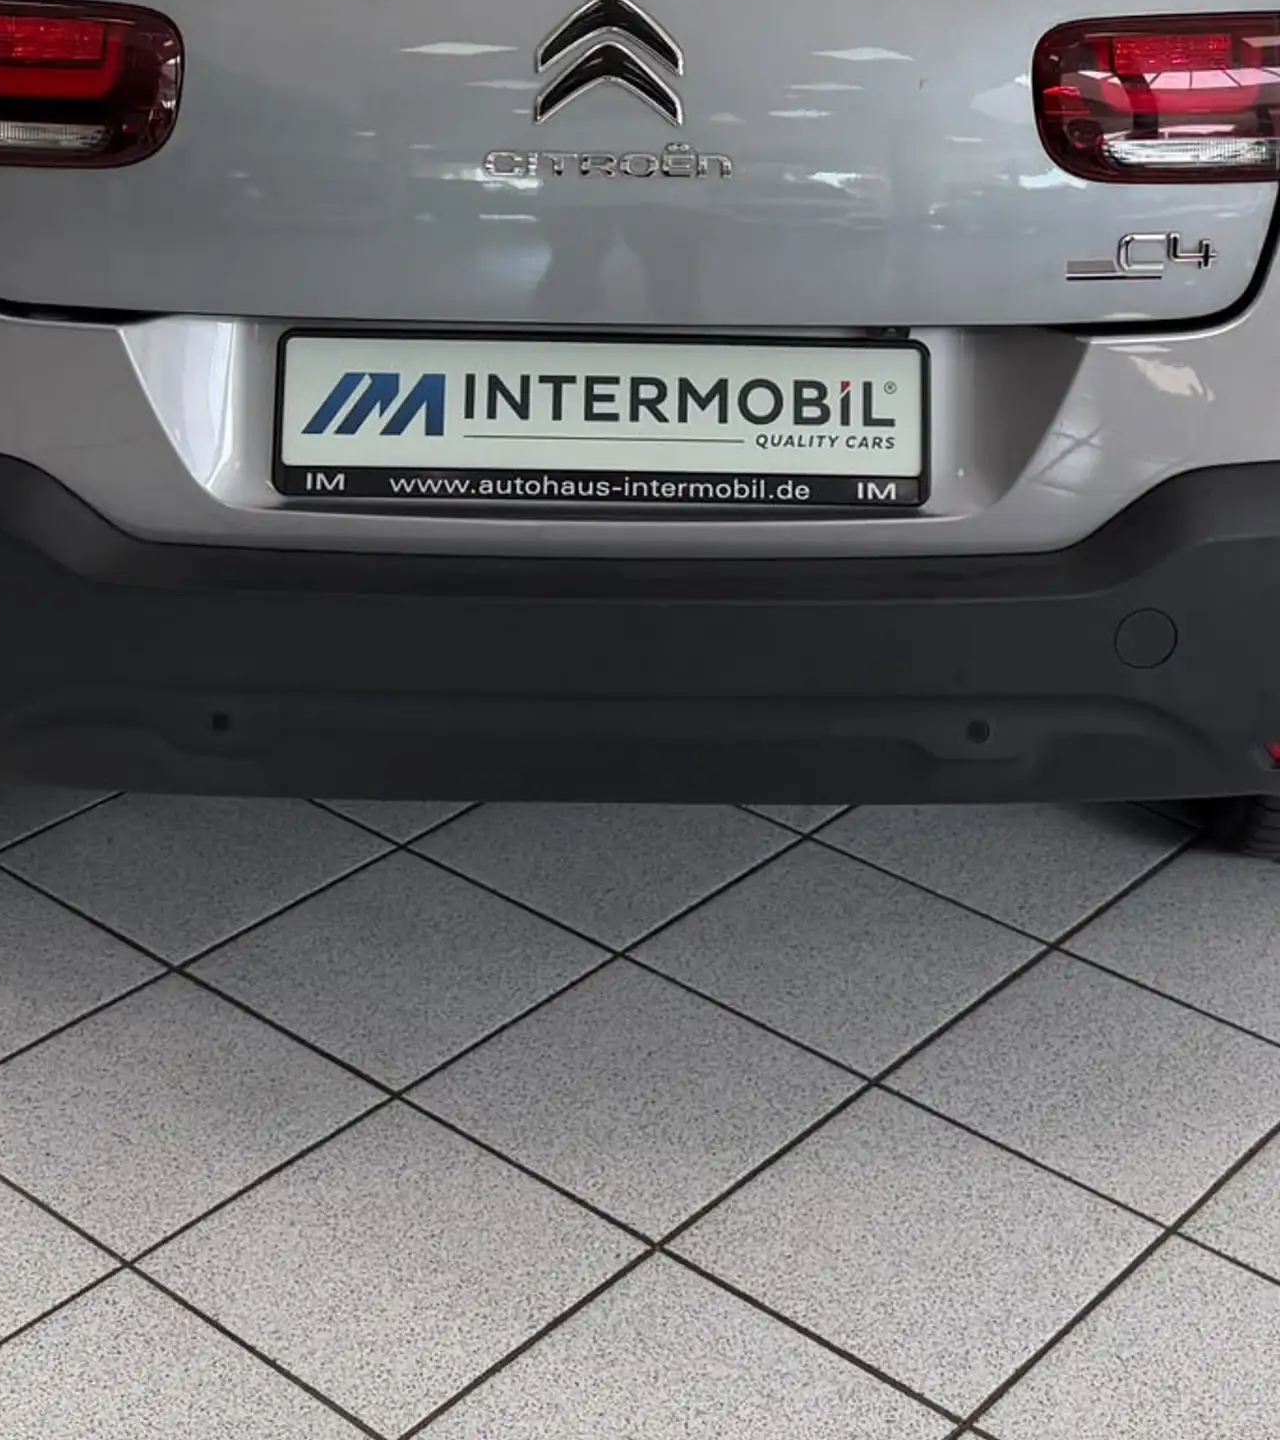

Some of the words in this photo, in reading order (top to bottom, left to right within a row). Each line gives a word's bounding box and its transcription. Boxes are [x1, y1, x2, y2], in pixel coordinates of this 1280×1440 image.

[1117, 231, 1219, 271] C4
[755, 433, 840, 449] QUALITY
[845, 434, 896, 450] CARS
[305, 472, 346, 491] IM
[389, 475, 811, 501] www.autohaus-intermobil.de
[856, 481, 897, 501] IM
